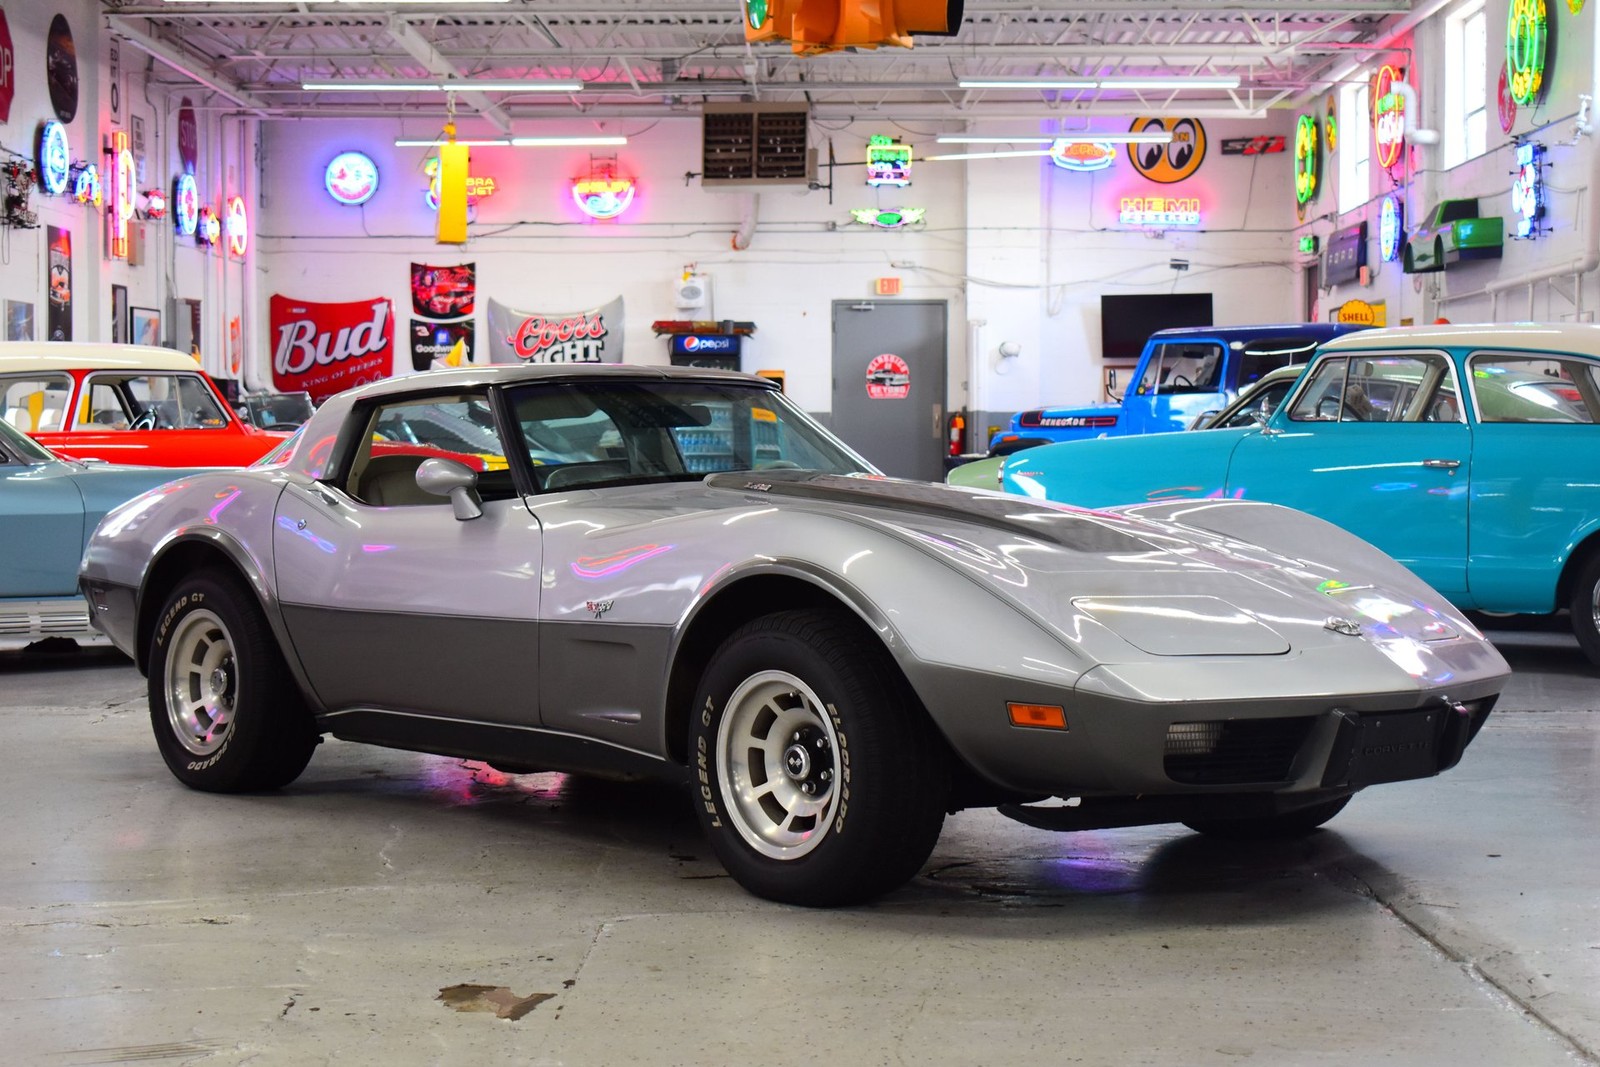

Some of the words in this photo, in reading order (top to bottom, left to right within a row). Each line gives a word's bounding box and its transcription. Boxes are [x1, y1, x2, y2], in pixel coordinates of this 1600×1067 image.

[465, 177, 494, 186] BRA
[1121, 197, 1200, 213] HEMI
[1328, 247, 1353, 265] FORD
[1343, 313, 1370, 323] SHELL
[275, 301, 388, 375] Bud
[507, 313, 608, 358] Coors
[700, 339, 729, 349] pepsi
[523, 340, 604, 363] IGHT
[302, 376, 328, 388] KING
[332, 371, 345, 380] OF
[349, 358, 383, 374] BEERS
[1040, 417, 1086, 427] RENEGADE
[156, 596, 188, 646] LEGEND
[191, 593, 205, 602] GT
[702, 695, 716, 727] GT
[826, 703, 852, 834] ELDORADO
[698, 735, 723, 829] LEGEND
